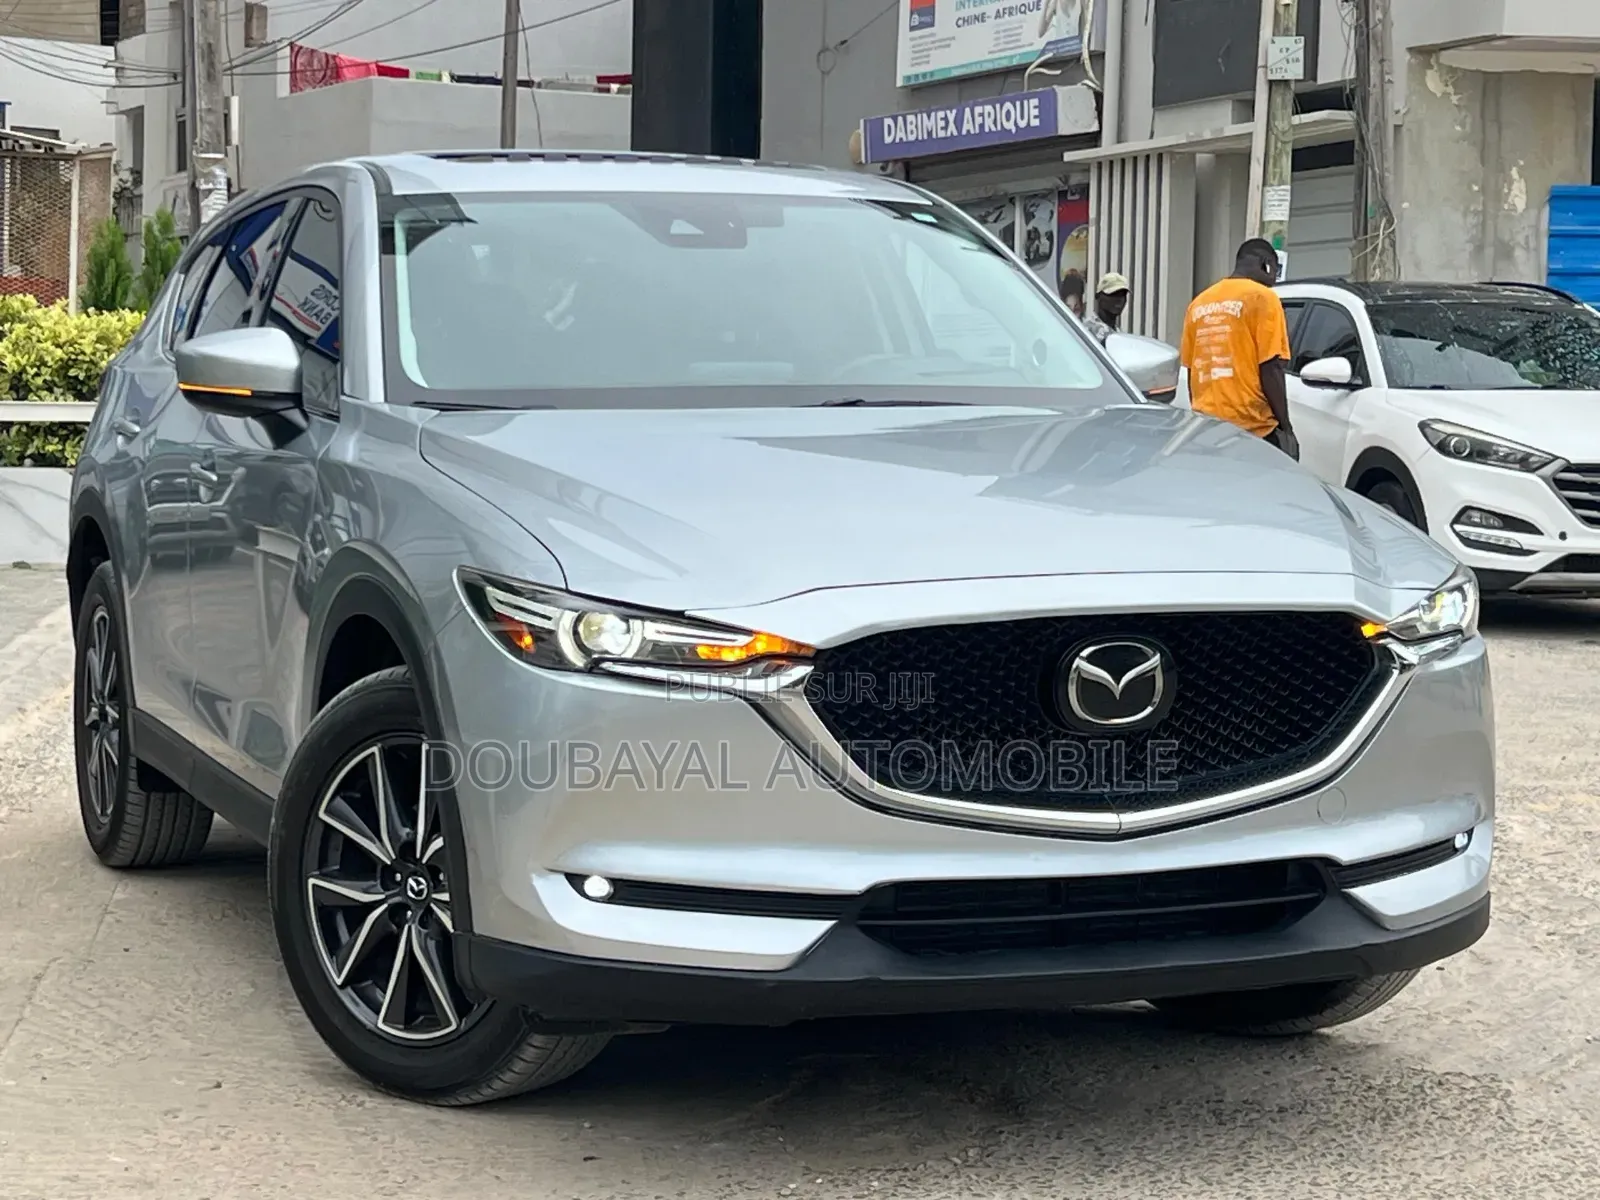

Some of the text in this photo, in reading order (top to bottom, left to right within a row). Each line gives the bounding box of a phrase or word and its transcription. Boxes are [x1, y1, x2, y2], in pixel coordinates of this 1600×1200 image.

[994, 0, 1042, 20] AFRIQUE
[884, 98, 1040, 144] DABIMEX AFRIQUE
